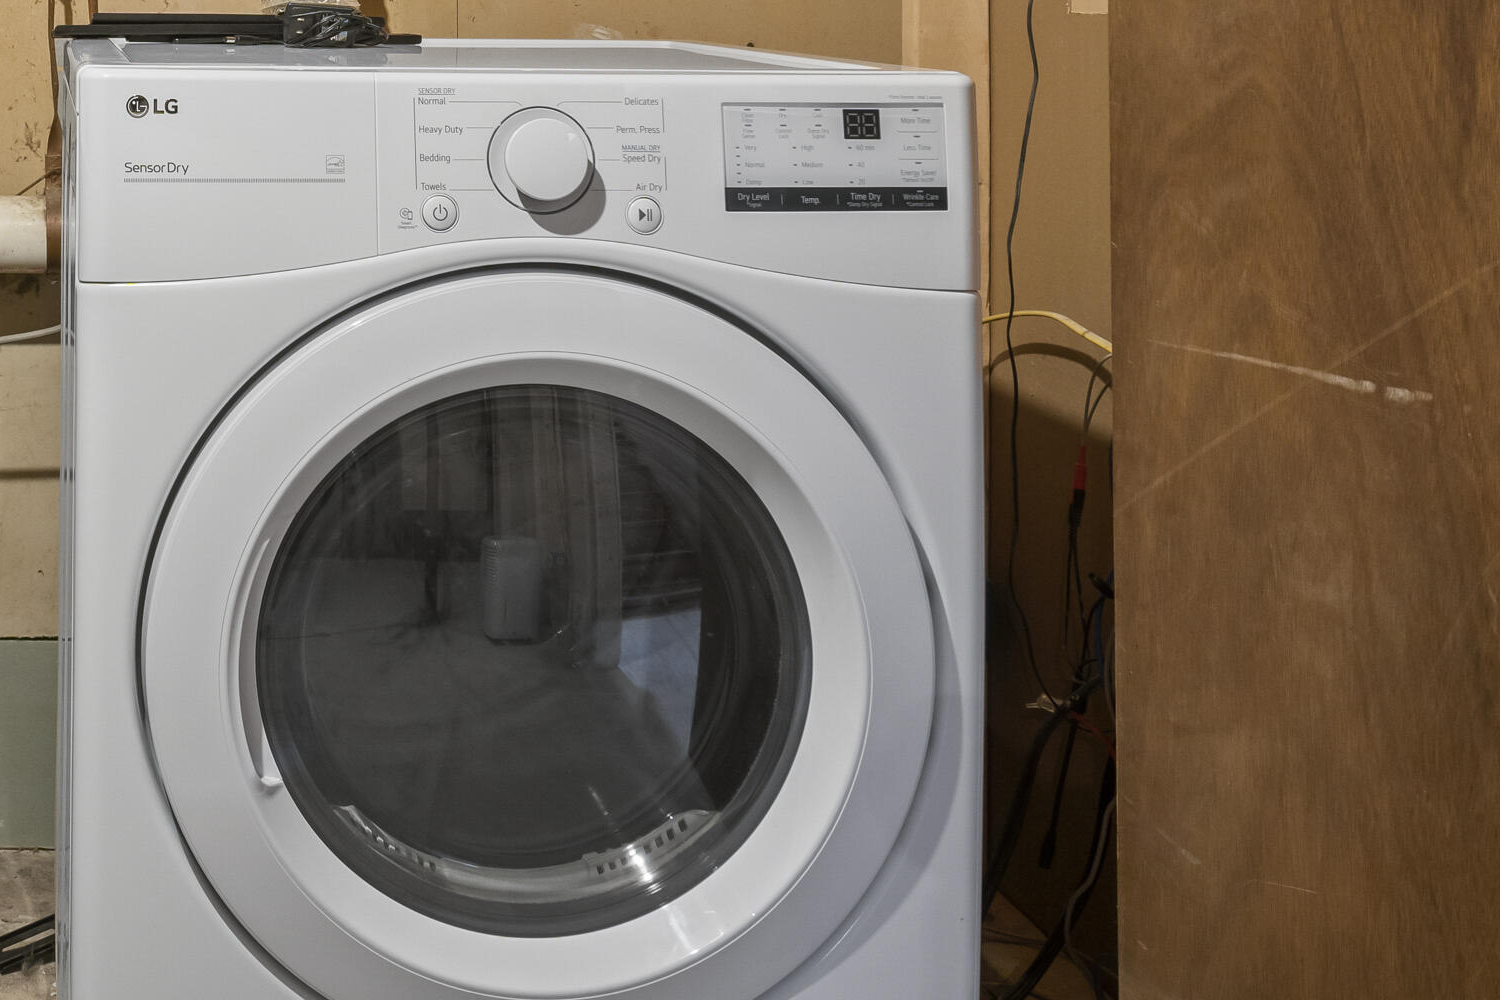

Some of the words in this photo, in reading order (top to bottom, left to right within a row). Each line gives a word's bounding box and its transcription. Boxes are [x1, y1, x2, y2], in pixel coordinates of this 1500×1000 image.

[153, 98, 179, 114] LG
[418, 97, 446, 105] Normal
[624, 97, 659, 106] Delicates
[418, 125, 442, 135] Heavy
[444, 125, 464, 135] Duty
[616, 125, 636, 134] Perm.
[639, 125, 661, 134] Press
[419, 154, 451, 164] Bedding
[622, 154, 646, 164] Speed
[647, 154, 661, 164] Dry
[124, 162, 166, 173] Sensor
[167, 162, 190, 176] Dry
[900, 170, 920, 178] Energy
[420, 182, 447, 191] Towels
[636, 183, 647, 191] Air
[649, 183, 663, 193] Dry
[737, 192, 751, 202] Dry
[752, 192, 770, 201] Level
[850, 192, 867, 201] Time
[868, 192, 881, 202] Dry
